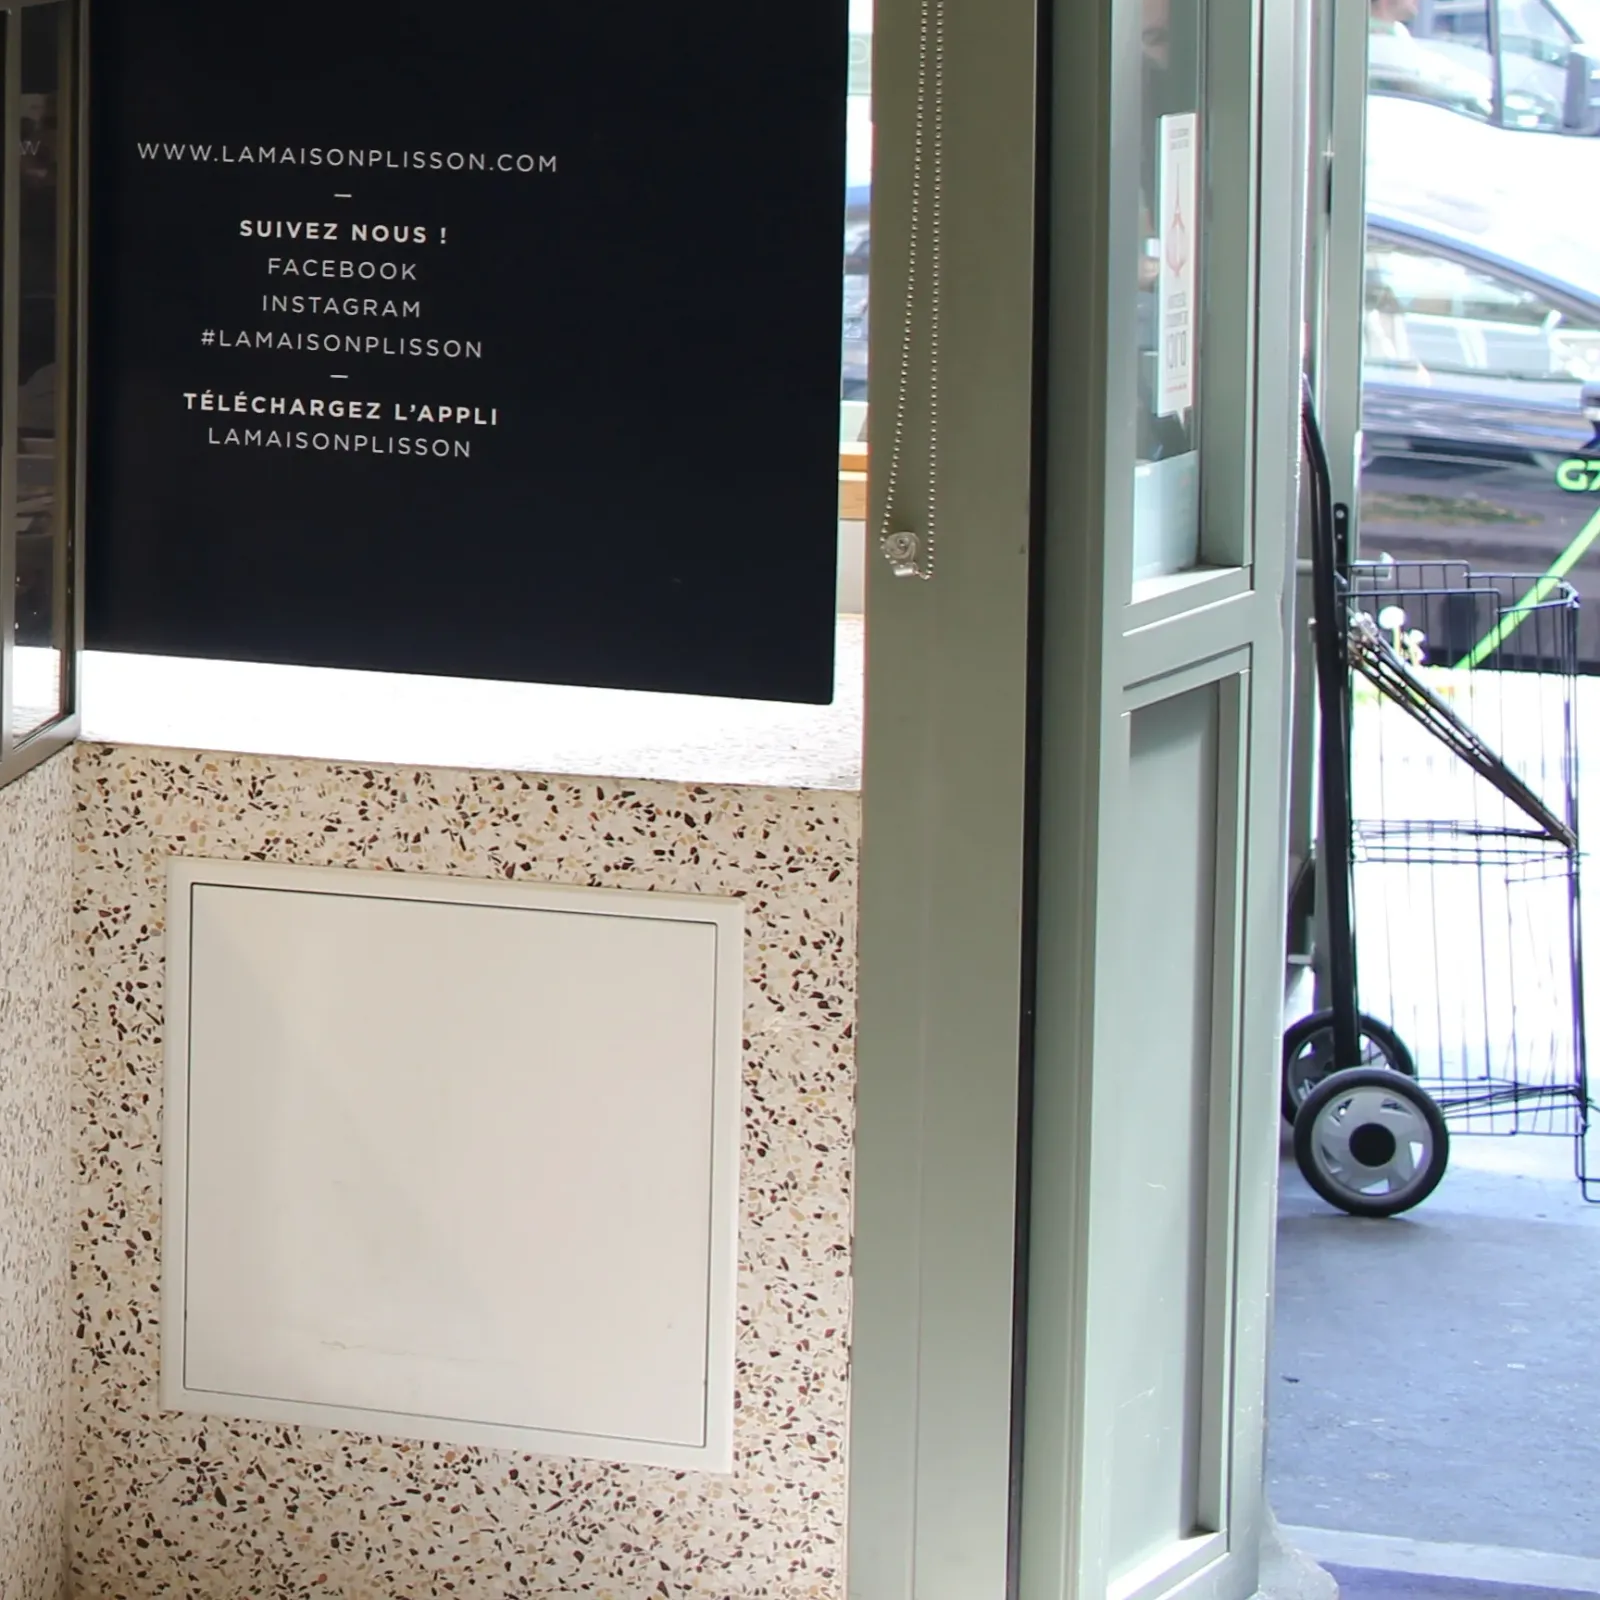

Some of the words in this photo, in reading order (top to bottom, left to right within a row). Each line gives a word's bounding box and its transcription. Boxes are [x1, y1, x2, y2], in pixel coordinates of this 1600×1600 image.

[137, 142, 558, 173] WWW.LAMAISONPLISSON.COM
[239, 219, 339, 241] SUIVEZ
[351, 223, 428, 244] NOUS
[267, 257, 418, 281] FACEBOOK
[262, 294, 421, 318] INSTAGRAM
[200, 328, 483, 359] #LAMAISONPLISSON
[182, 389, 382, 420] TÉLÉCHARGEZ
[208, 427, 471, 458] LAMAISONPLISSON
